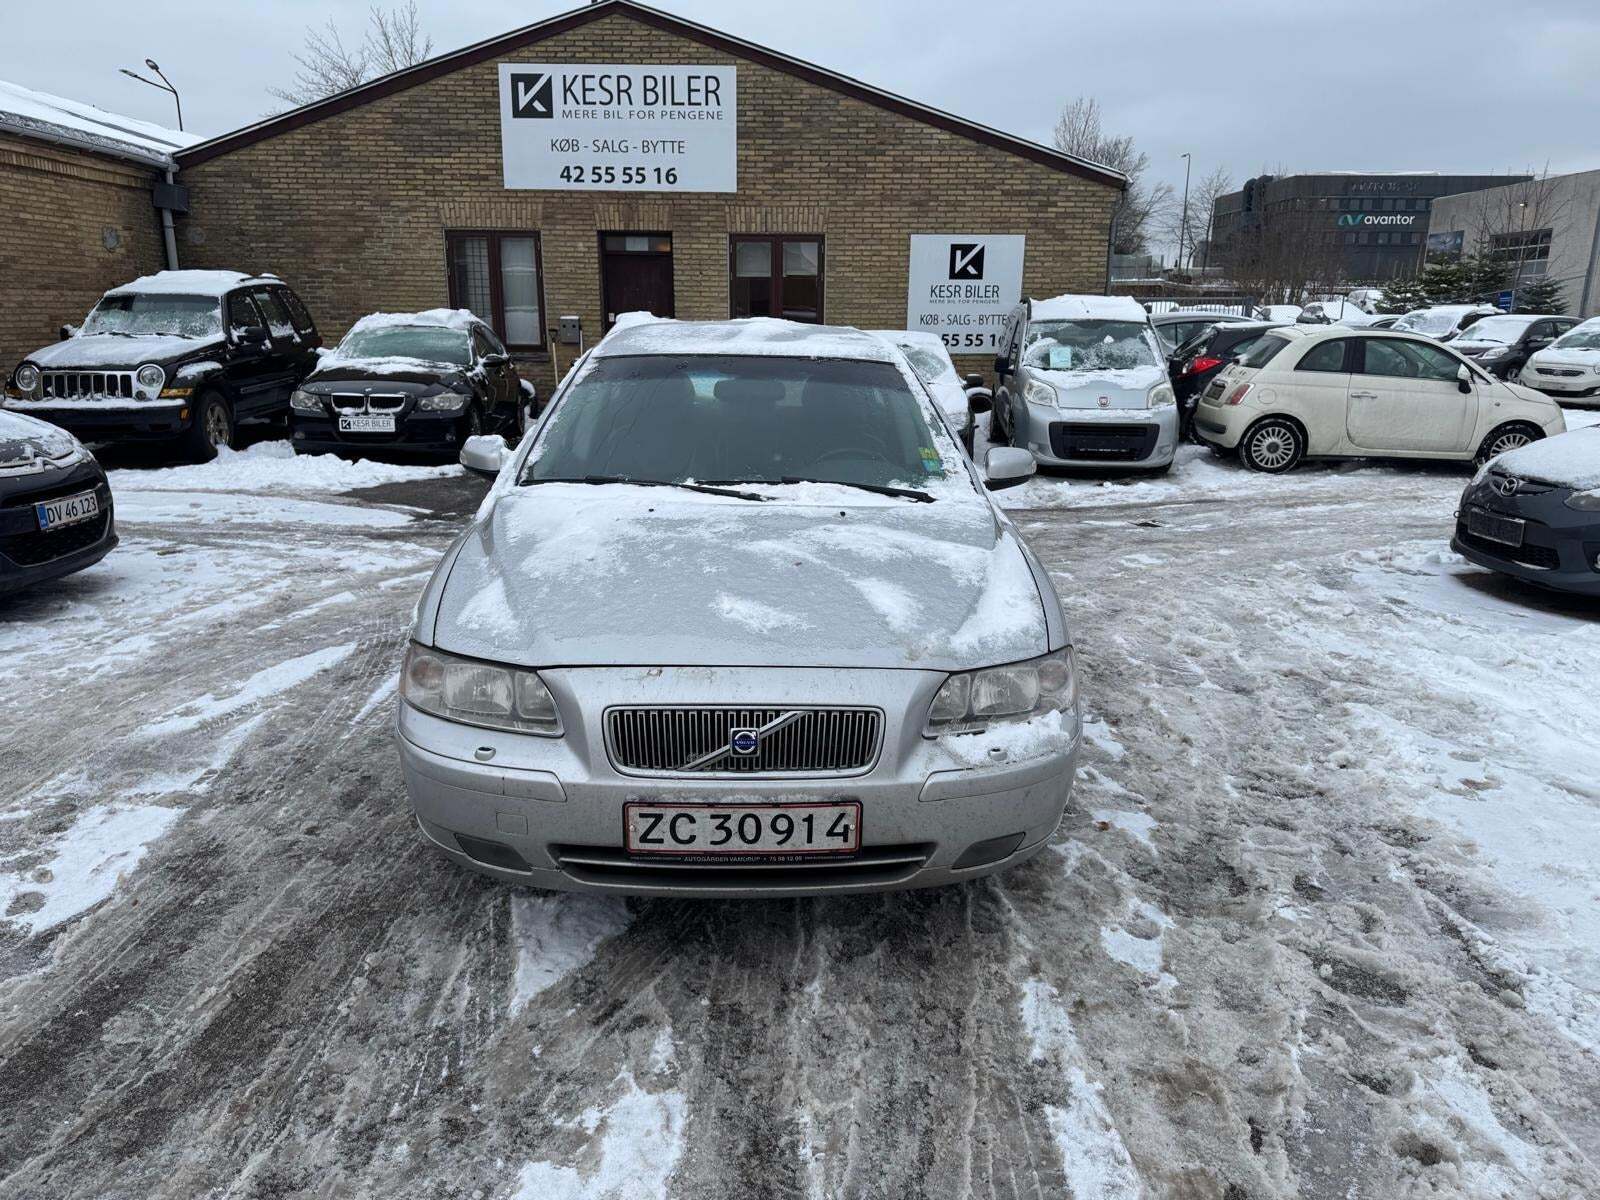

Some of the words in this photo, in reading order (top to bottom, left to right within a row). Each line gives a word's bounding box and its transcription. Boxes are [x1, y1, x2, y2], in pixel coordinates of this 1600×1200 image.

[562, 74, 633, 105] KESR
[643, 75, 721, 106] BILER
[561, 109, 598, 119] MERE
[603, 110, 624, 120] BIL
[629, 110, 655, 120] FOR
[660, 110, 723, 121] PENGENE
[551, 138, 580, 153] KØB
[592, 139, 629, 153] SALG
[641, 140, 685, 154] BYTTE
[560, 165, 584, 183] 42
[591, 166, 615, 183] 55
[622, 166, 646, 184] 55
[653, 167, 678, 184] 16
[1364, 214, 1415, 225] avantor
[930, 285, 961, 298] KESR
[965, 285, 999, 298] BILER
[920, 314, 939, 325] KØB
[946, 314, 971, 325] SALG
[978, 314, 1007, 325] BYTTE
[941, 333, 960, 346] 55
[964, 333, 984, 347] 55
[47, 504, 62, 523] DV
[65, 500, 78, 518] 46
[80, 496, 97, 514] 123
